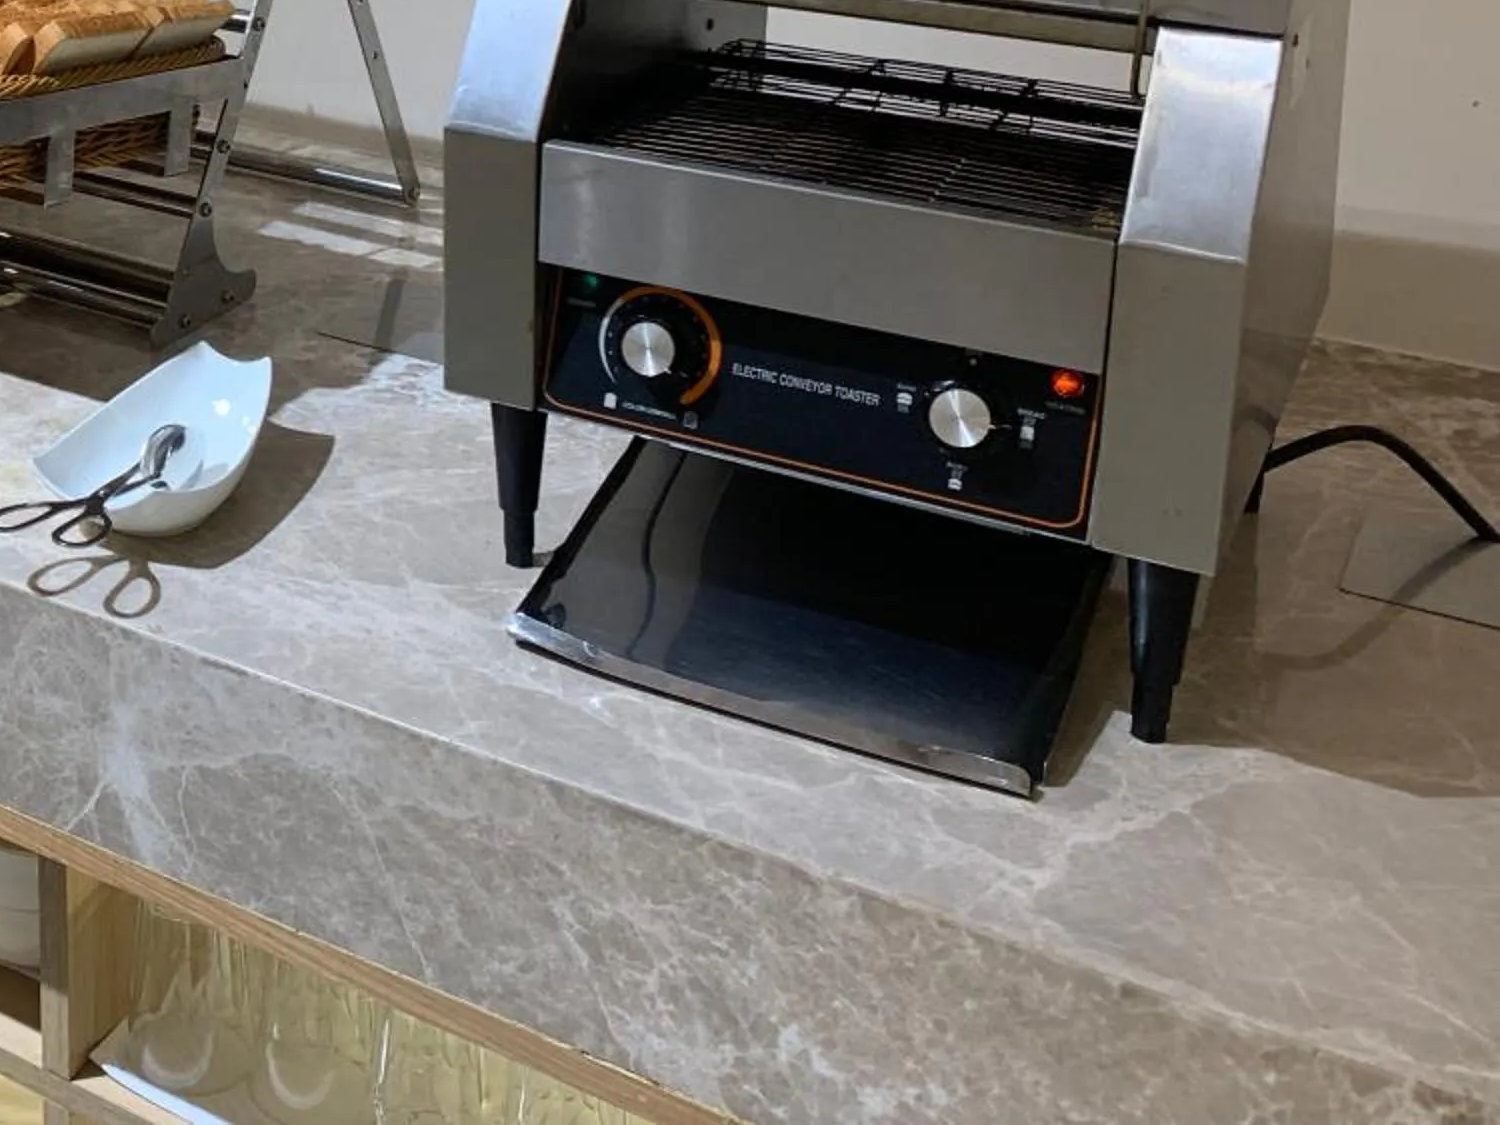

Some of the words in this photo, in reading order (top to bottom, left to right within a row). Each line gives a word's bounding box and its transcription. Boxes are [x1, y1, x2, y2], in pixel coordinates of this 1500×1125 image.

[731, 362, 779, 384] ELECTRIC
[779, 374, 833, 395] CONVEYOR
[835, 385, 881, 406] TOASTER
